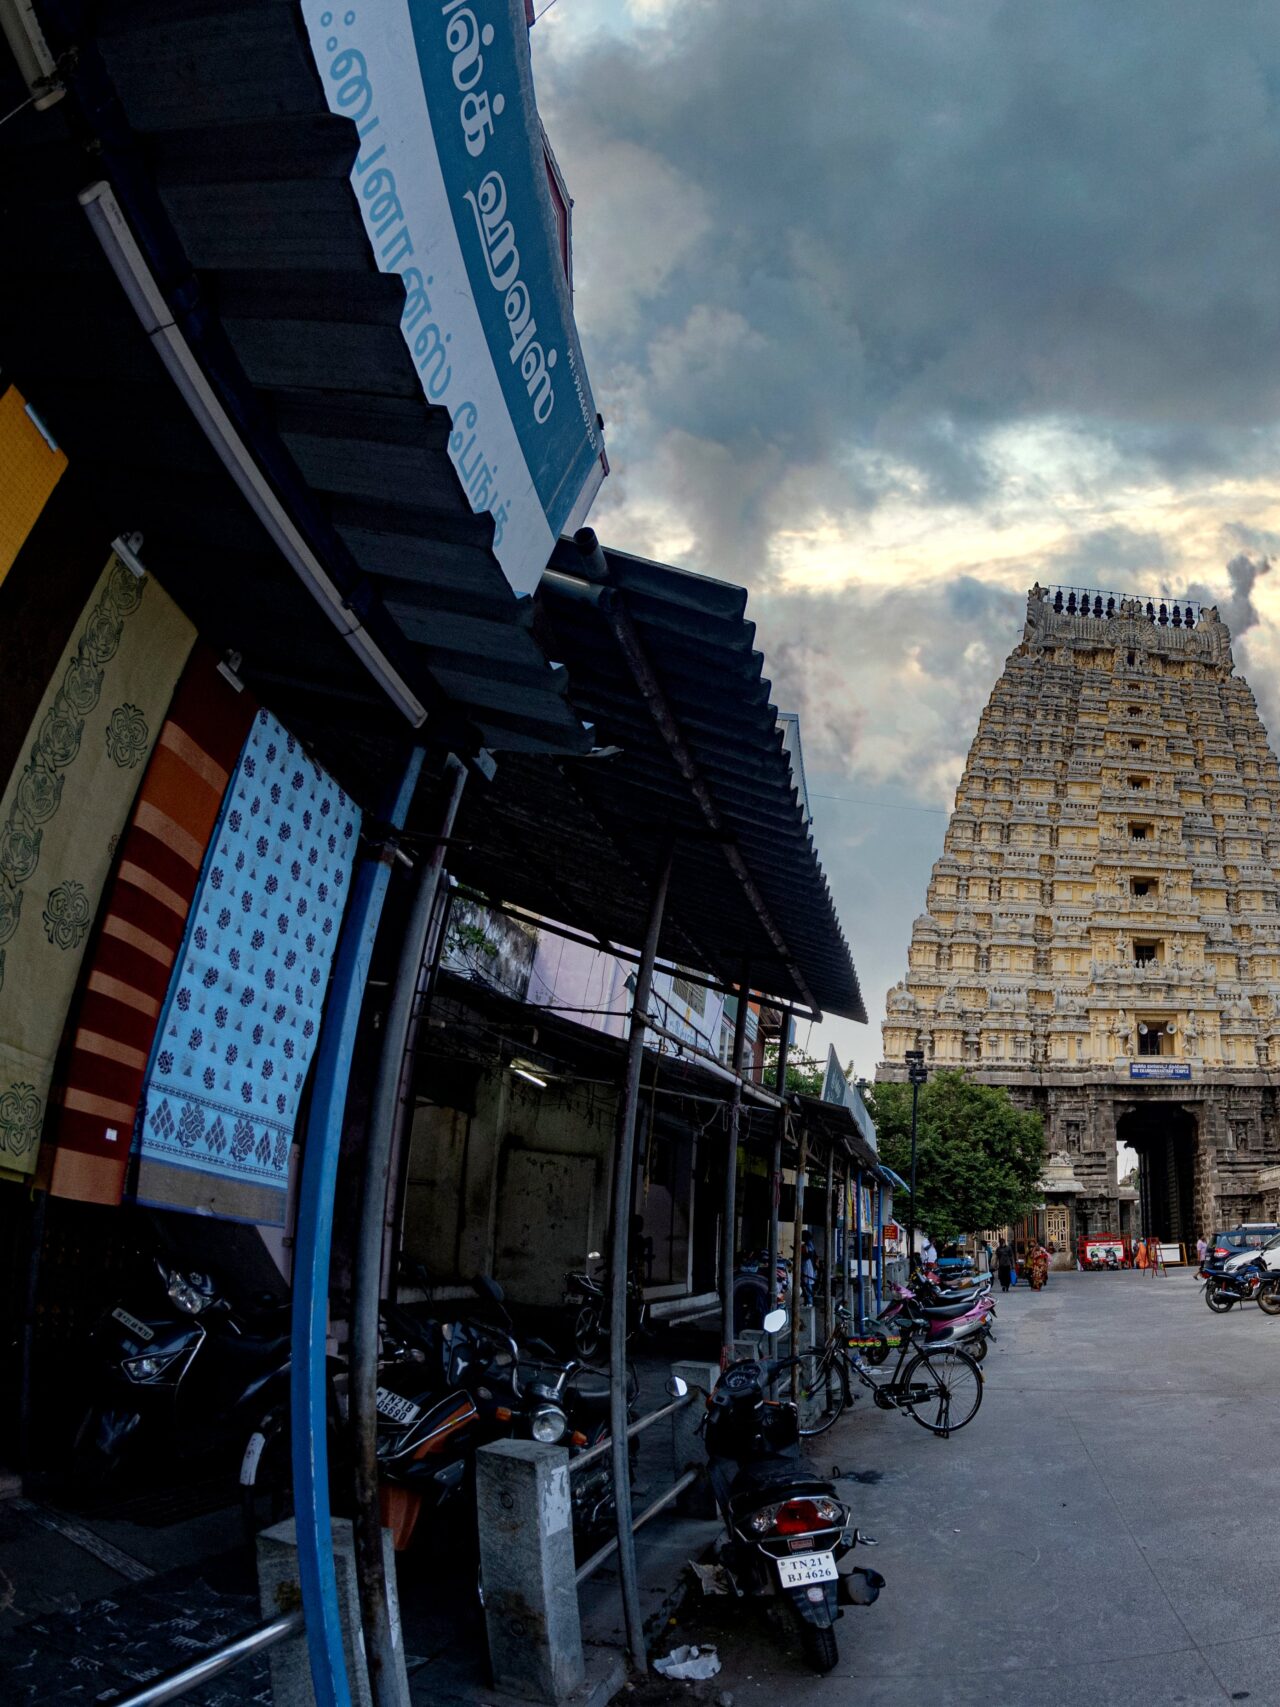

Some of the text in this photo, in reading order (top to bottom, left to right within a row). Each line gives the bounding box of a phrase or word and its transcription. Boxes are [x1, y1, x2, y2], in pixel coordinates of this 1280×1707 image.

[442, 0, 557, 426] ல்க் ஹவுஸ்
[790, 1557, 823, 1570] TN 21
[788, 1568, 832, 1583] BJ 4626
